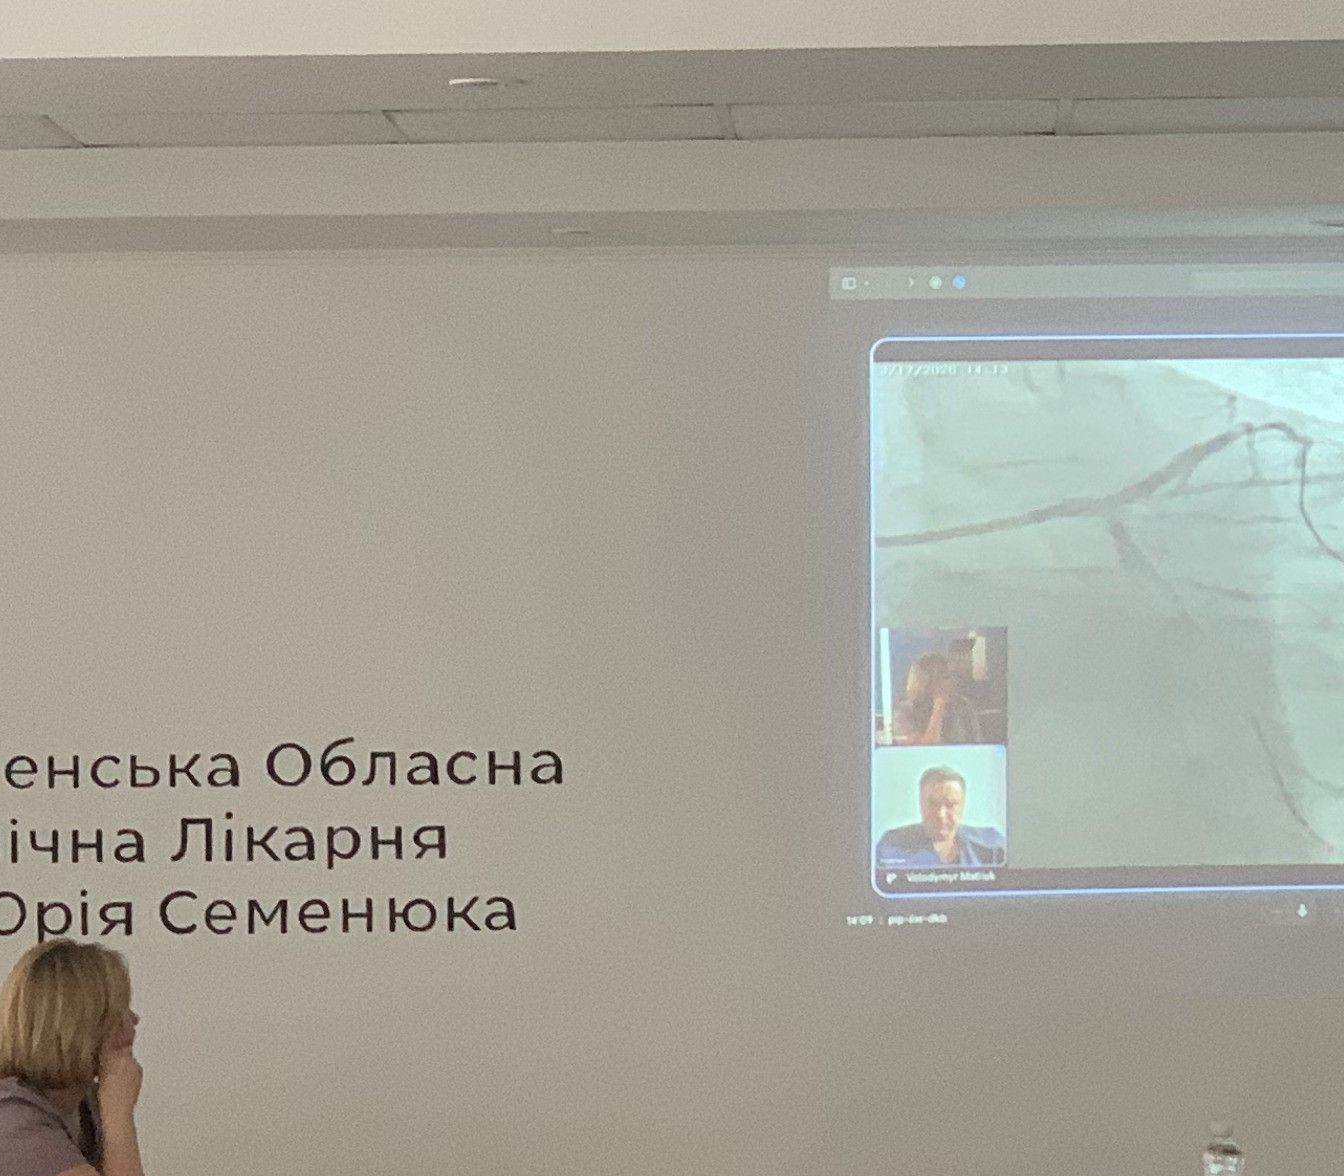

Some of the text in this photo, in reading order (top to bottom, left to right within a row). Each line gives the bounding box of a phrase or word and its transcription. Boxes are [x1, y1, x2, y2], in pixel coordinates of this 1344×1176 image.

[266, 736, 563, 787] Обласна
[170, 811, 447, 870] Лікарня
[159, 890, 517, 935] Семенюка
